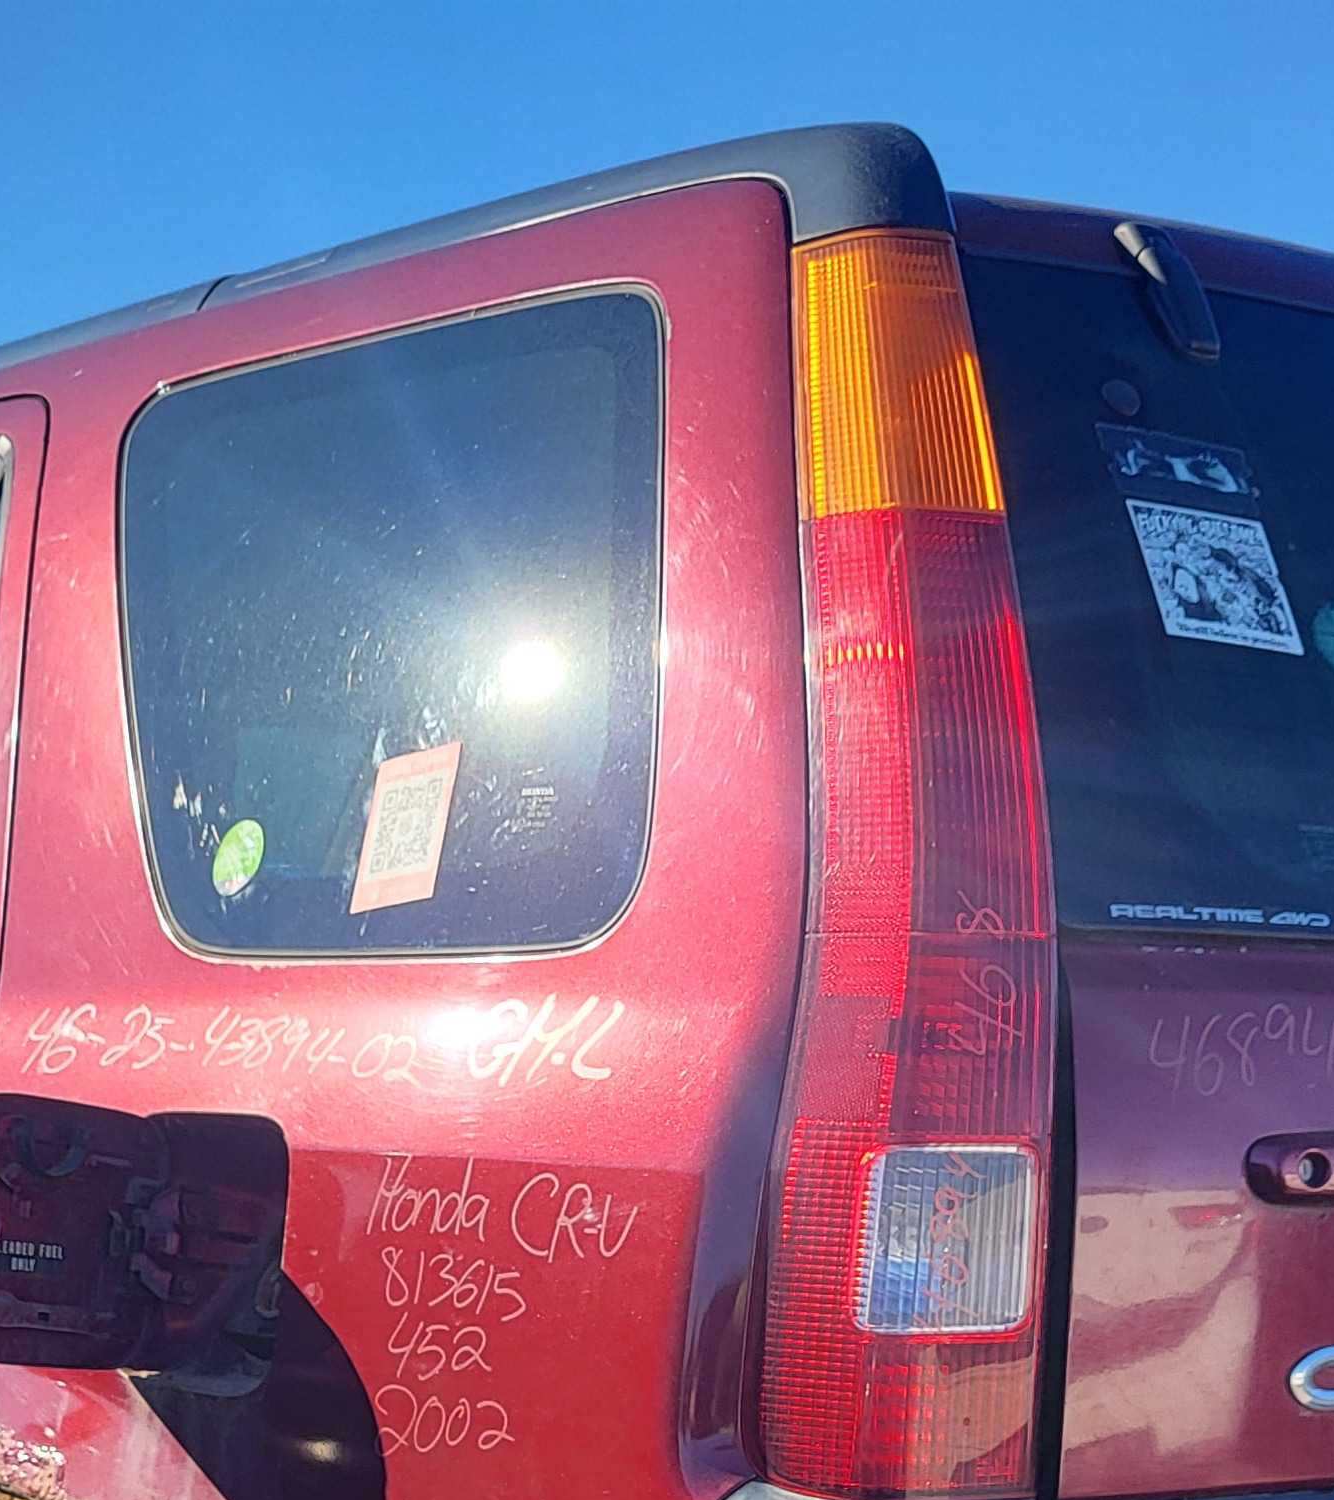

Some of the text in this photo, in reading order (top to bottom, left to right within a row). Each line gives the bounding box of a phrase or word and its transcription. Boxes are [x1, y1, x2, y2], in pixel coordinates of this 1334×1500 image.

[1109, 904, 1331, 927] REALTIME 4WD
[366, 1152, 490, 1242] Honda
[11, 1257, 36, 1272] ONLY
[39, 1243, 64, 1259] FUEL
[381, 1246, 526, 1321] 813615
[387, 1312, 492, 1380] 452
[374, 1384, 516, 1457] 2002
